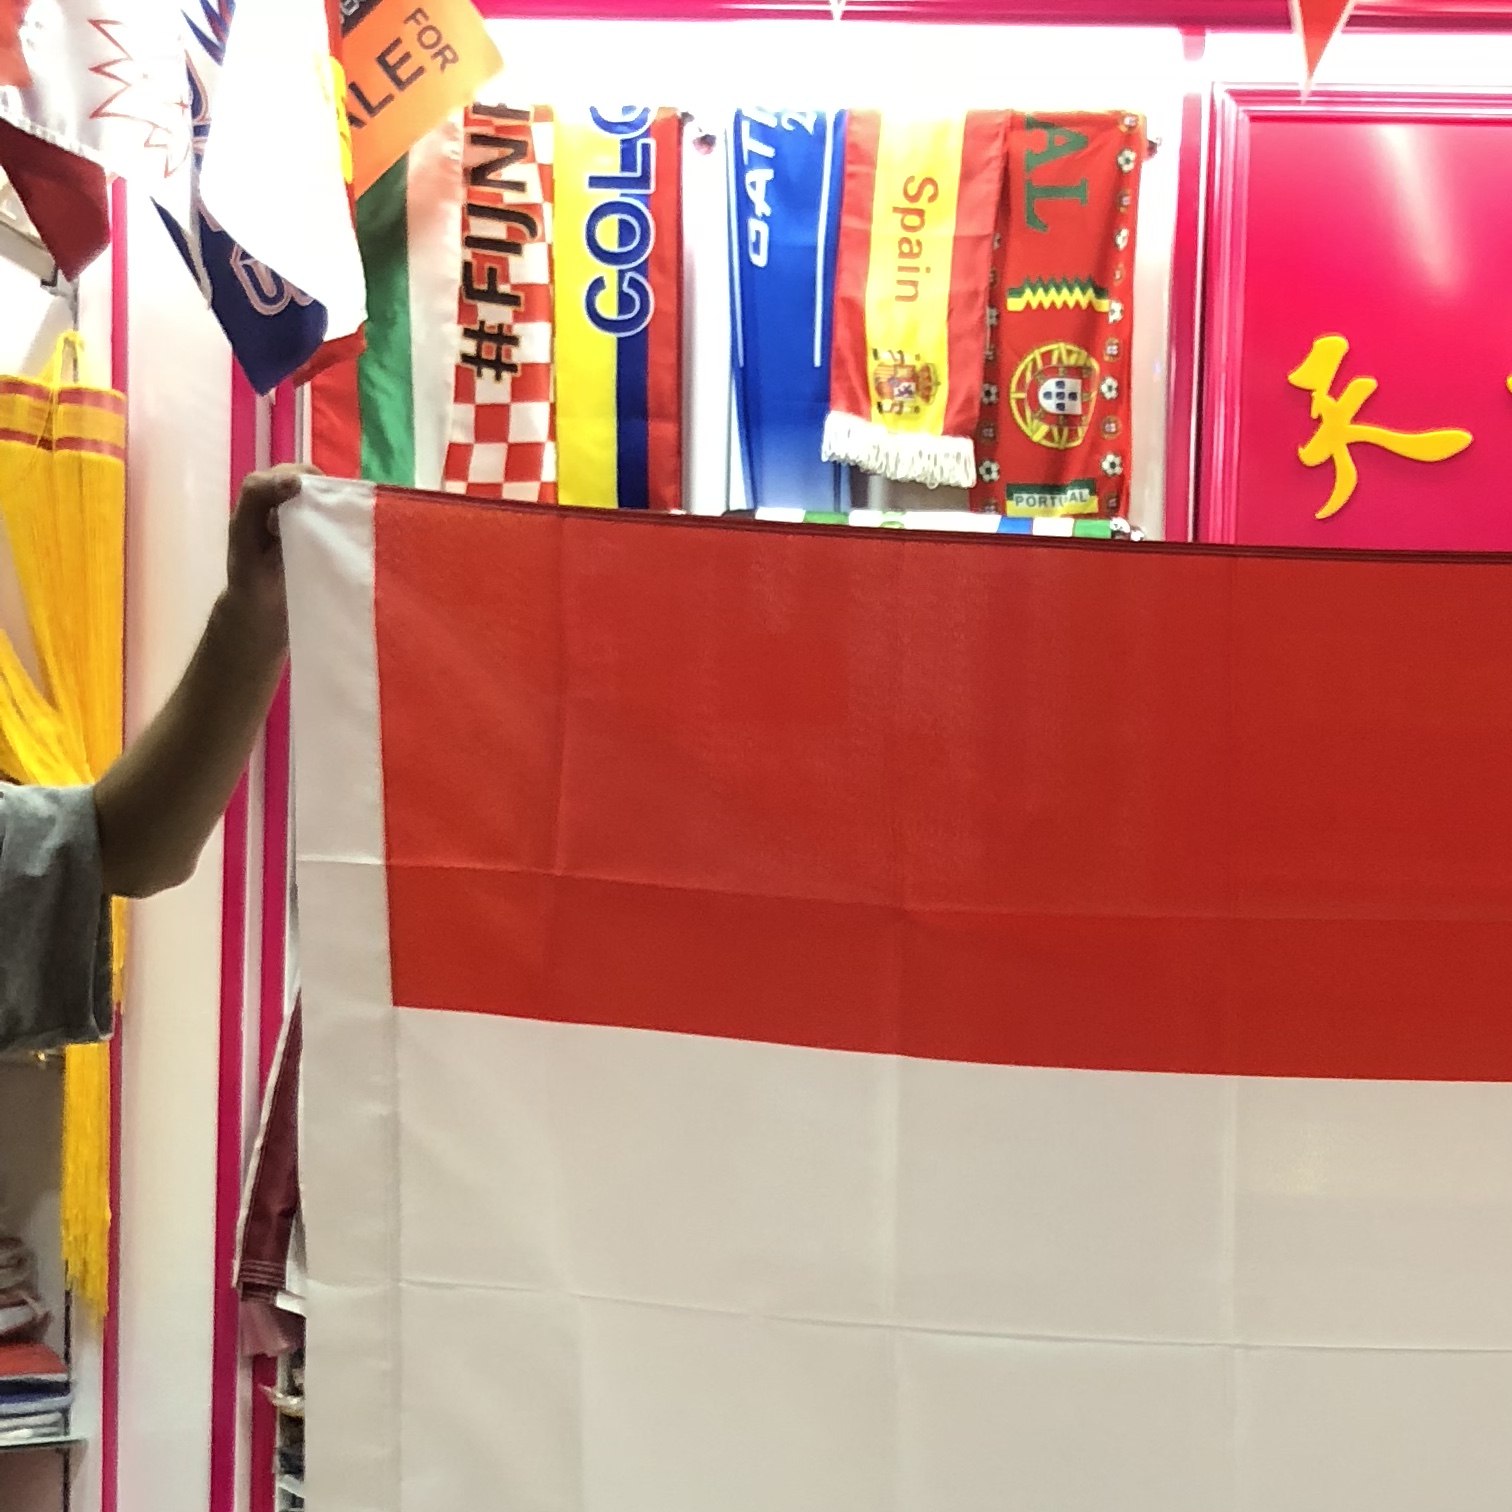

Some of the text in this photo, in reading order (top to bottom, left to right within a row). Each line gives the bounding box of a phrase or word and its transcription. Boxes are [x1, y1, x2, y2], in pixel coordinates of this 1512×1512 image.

[403, 7, 460, 73] FOR
[1024, 115, 1089, 234] AL
[892, 174, 940, 302] Spain
